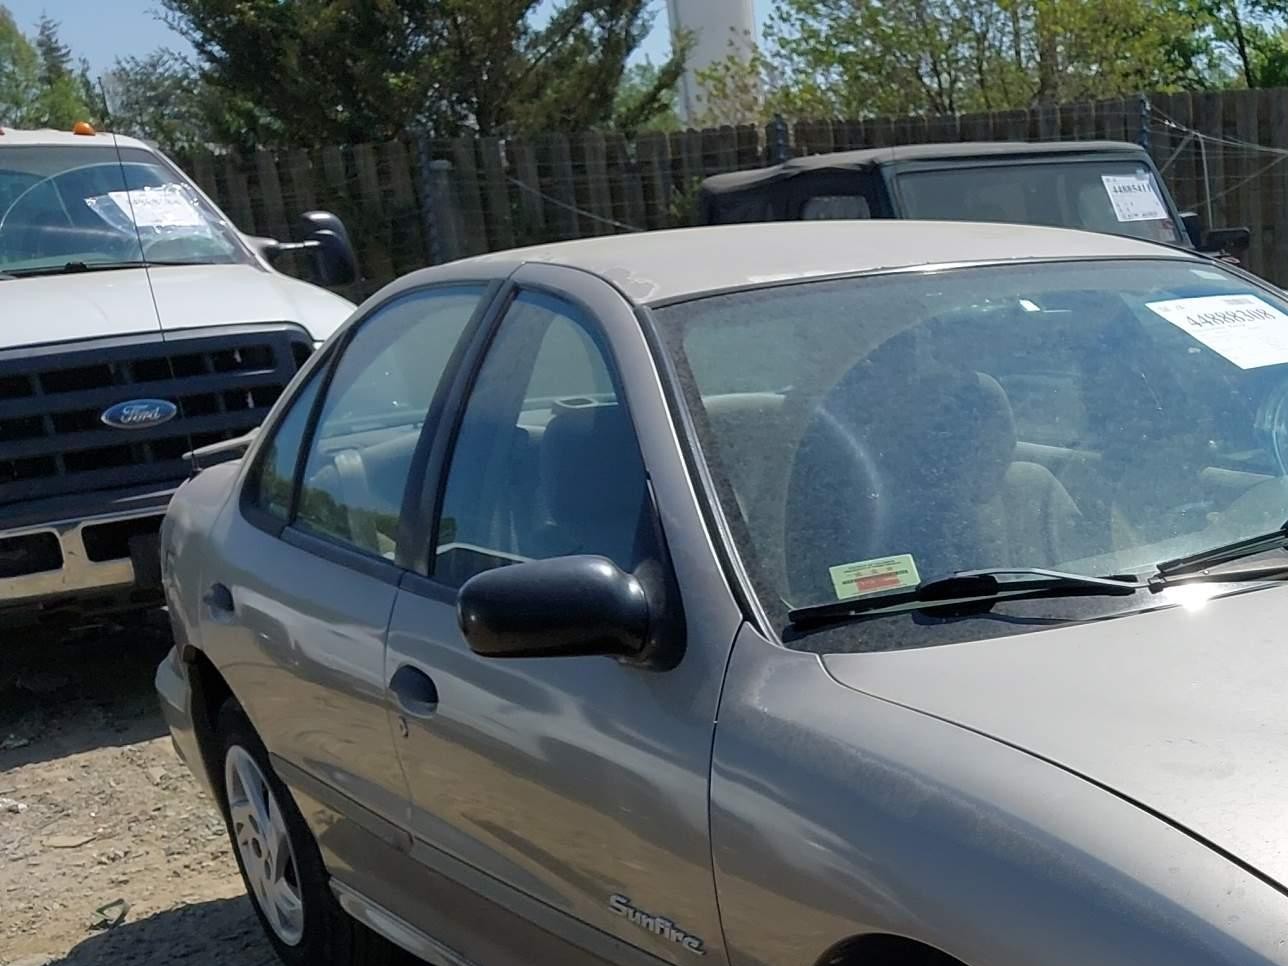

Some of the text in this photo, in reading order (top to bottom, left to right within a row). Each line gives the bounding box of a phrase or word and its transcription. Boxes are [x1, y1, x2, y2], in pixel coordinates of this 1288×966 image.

[1185, 308, 1277, 328] 44888308
[120, 404, 161, 424] Ford
[607, 894, 705, 956] Sunfire
